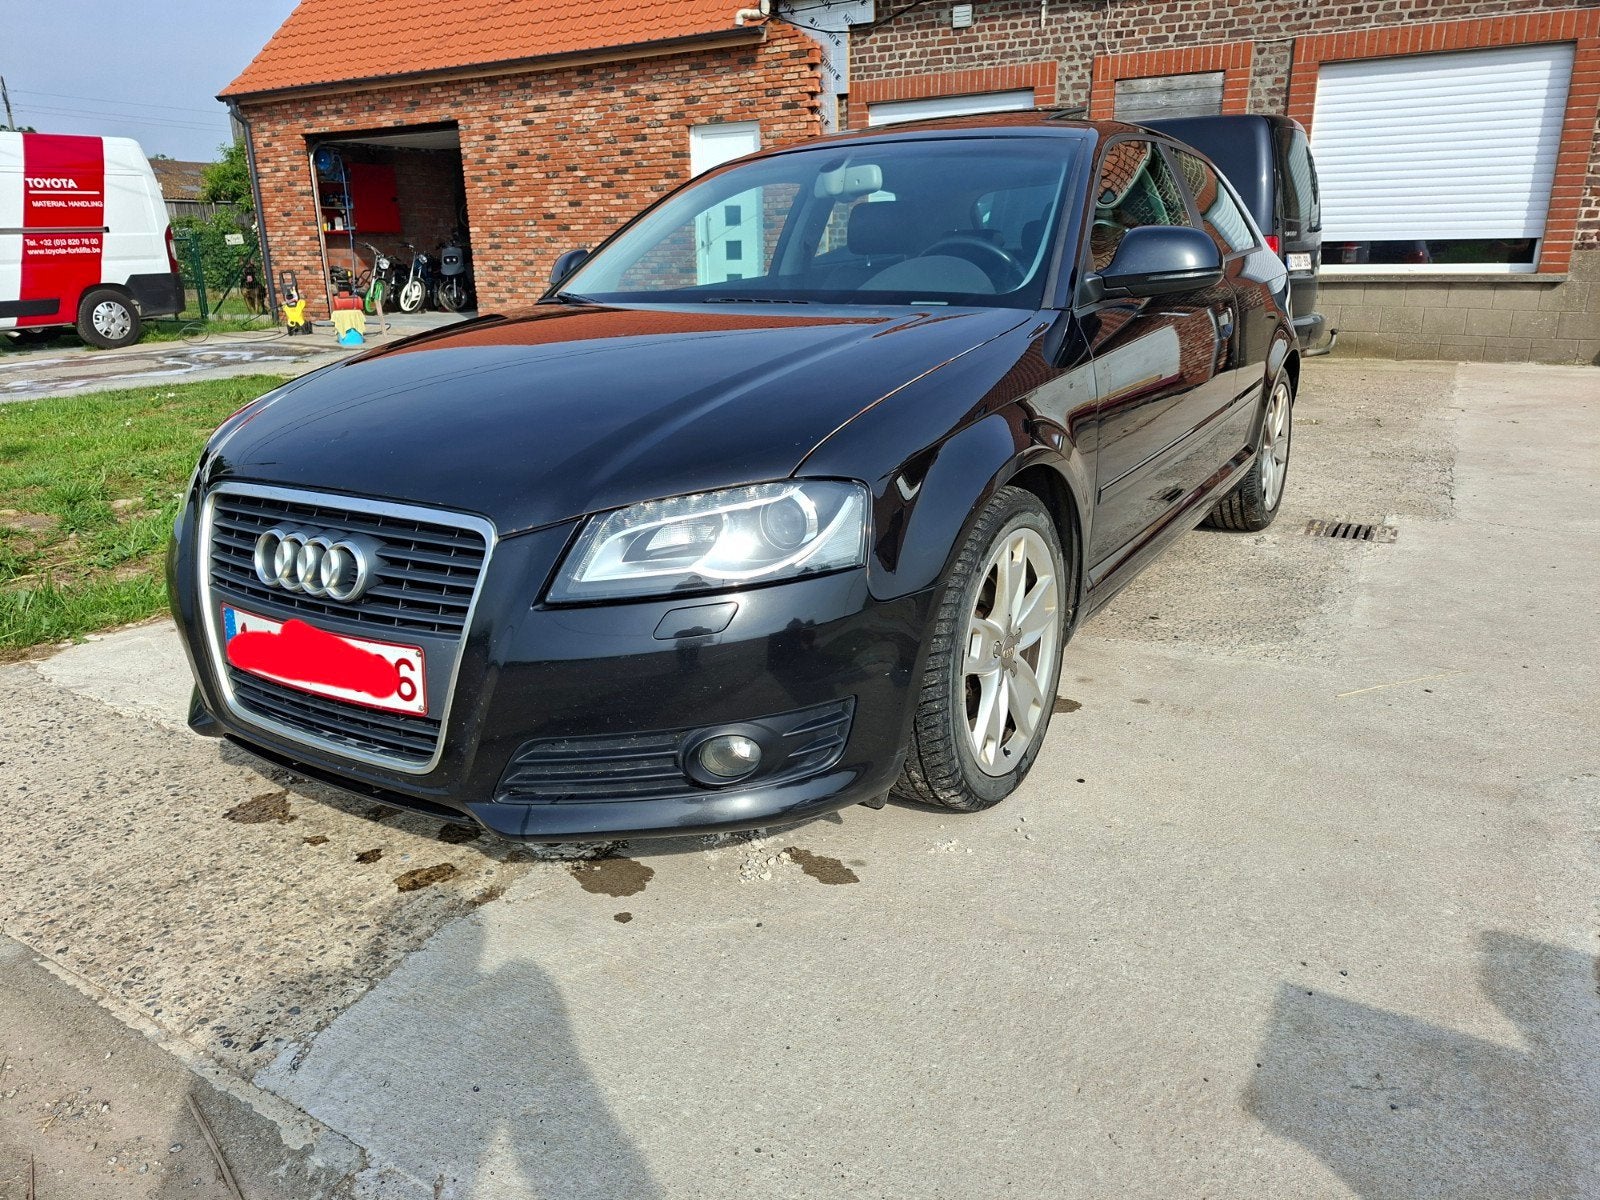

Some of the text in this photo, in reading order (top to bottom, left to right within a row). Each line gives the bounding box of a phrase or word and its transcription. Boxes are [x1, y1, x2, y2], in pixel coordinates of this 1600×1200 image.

[25, 177, 78, 189] TOYOTA
[31, 200, 103, 208] MATERIAL HANDLING
[53, 238, 66, 247] (0)3
[67, 238, 80, 246] 820
[27, 247, 101, 256] www.toyota-forklifts.be
